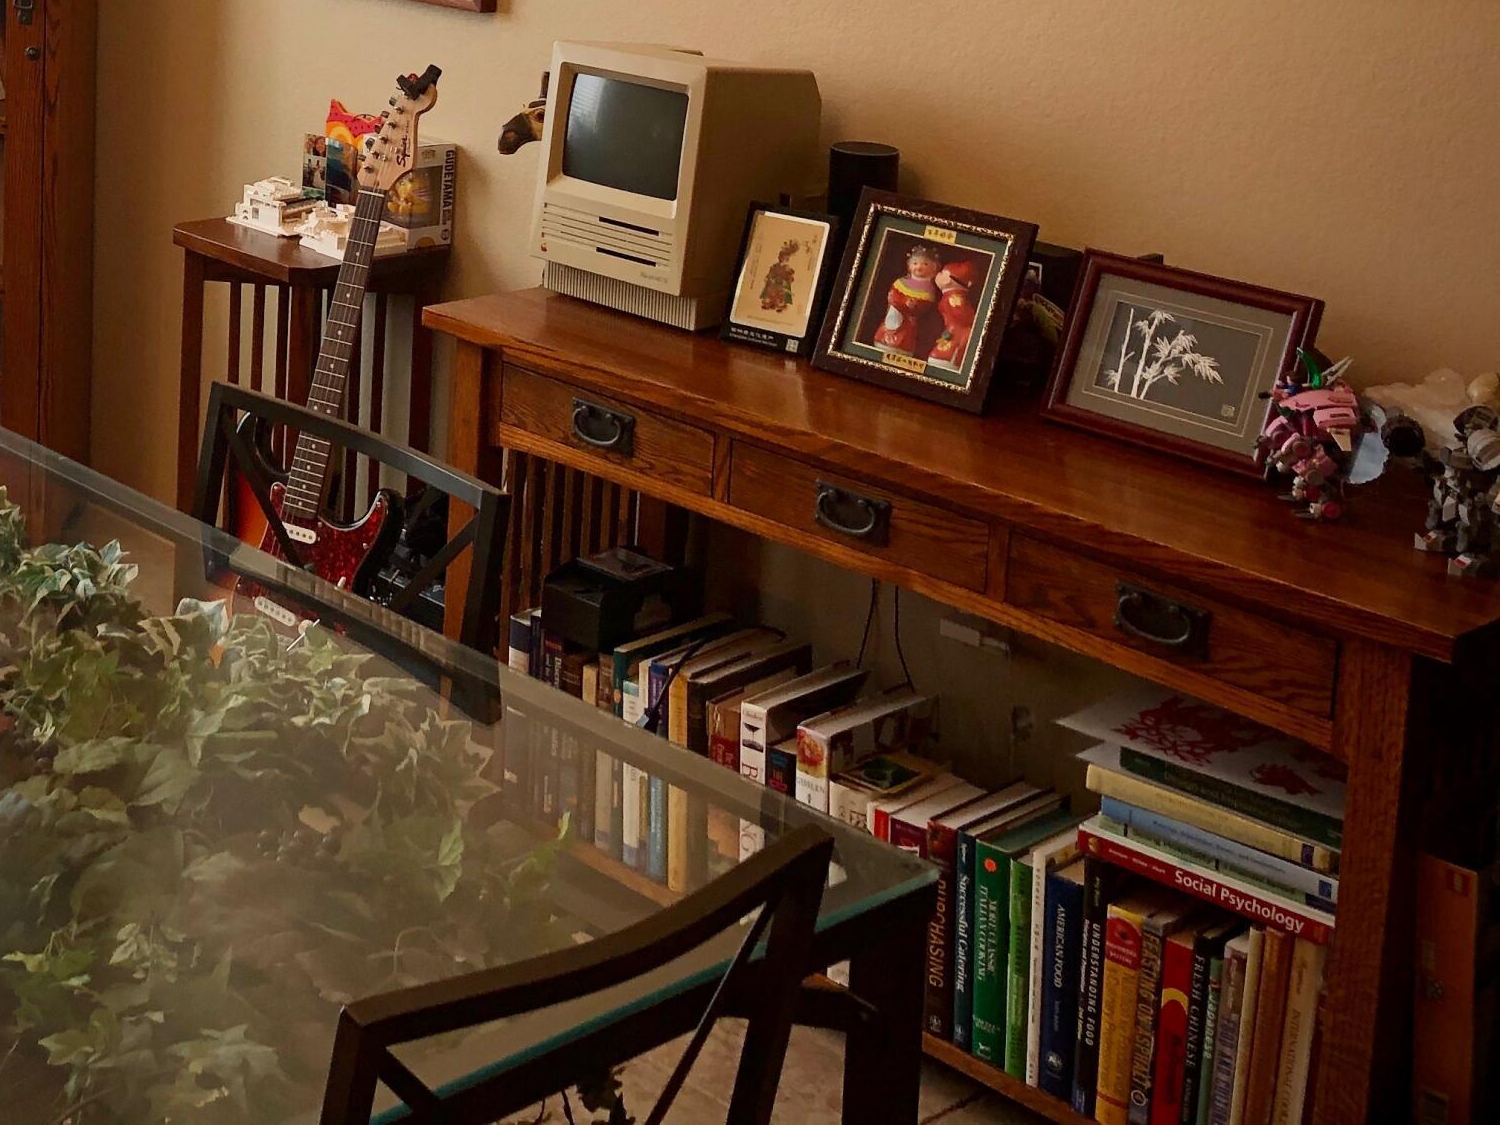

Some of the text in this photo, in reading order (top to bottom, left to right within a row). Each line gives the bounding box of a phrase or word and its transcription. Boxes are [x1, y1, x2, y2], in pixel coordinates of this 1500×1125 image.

[442, 150, 455, 209] GUDETAMA
[957, 873, 969, 938] Successful
[1054, 903, 1066, 957] AMERICAN
[1174, 869, 1305, 933] Social Psychology
[955, 939, 968, 994] Catering
[1052, 957, 1064, 989] FOOD
[1085, 923, 1100, 1047] UNDERSTANDING FOOD
[1190, 955, 1206, 1001] FRESH
[1131, 935, 1161, 1089] FEASTING ON ASPHALT
[1185, 1005, 1202, 1068] CHINESE
[1202, 994, 1218, 1060] Japanese
[1284, 1009, 1302, 1087] INTERNATIONAL
